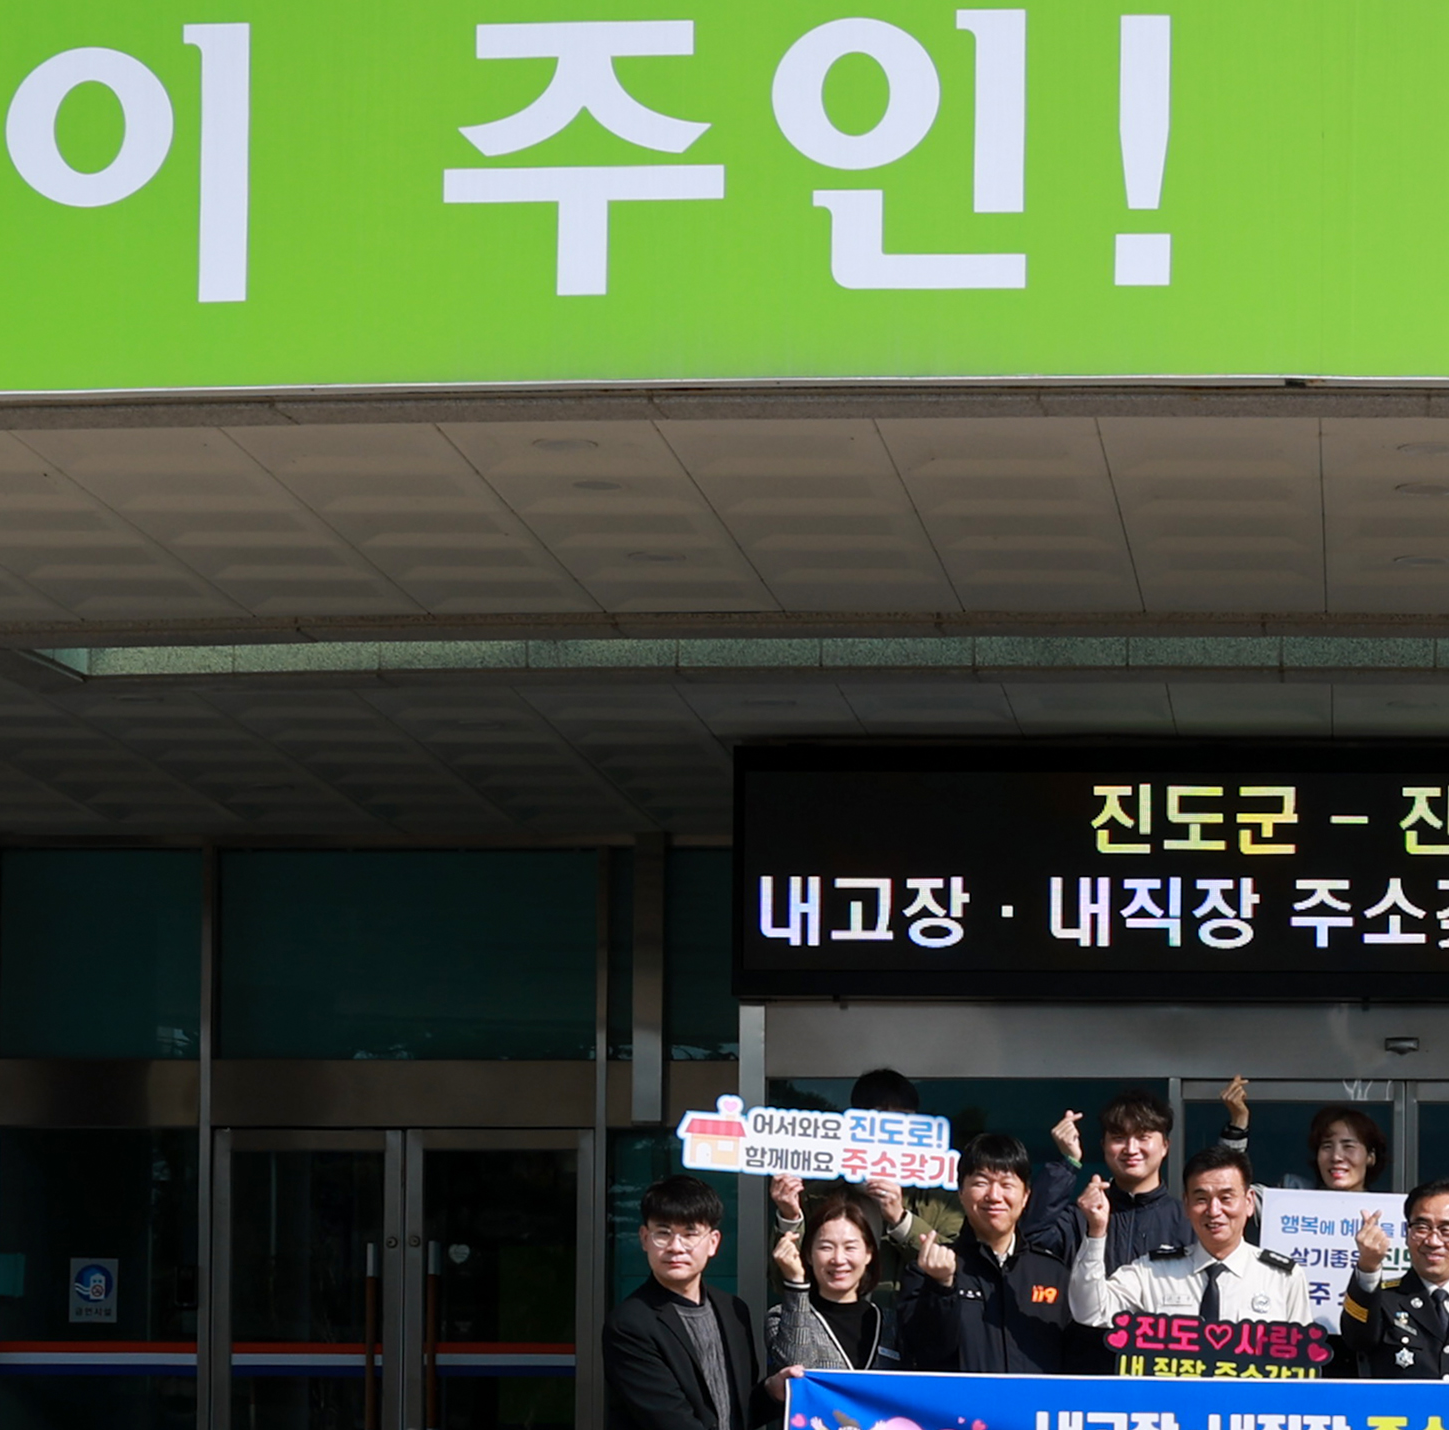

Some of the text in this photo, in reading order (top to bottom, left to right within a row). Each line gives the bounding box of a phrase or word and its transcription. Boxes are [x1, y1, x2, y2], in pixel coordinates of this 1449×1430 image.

[442, 9, 1172, 298] 주인!
[1091, 783, 1299, 855] 진도군
[759, 875, 970, 949] 내고장
[1049, 876, 1261, 949] 내직장
[753, 1113, 944, 1149] 어서와요 진도로!
[745, 1146, 955, 1183] 함께해요 주소갖기
[1280, 1215, 1335, 1236] 행복에
[1340, 1218, 1394, 1238] 혜을
[1135, 1316, 1200, 1351] 진도
